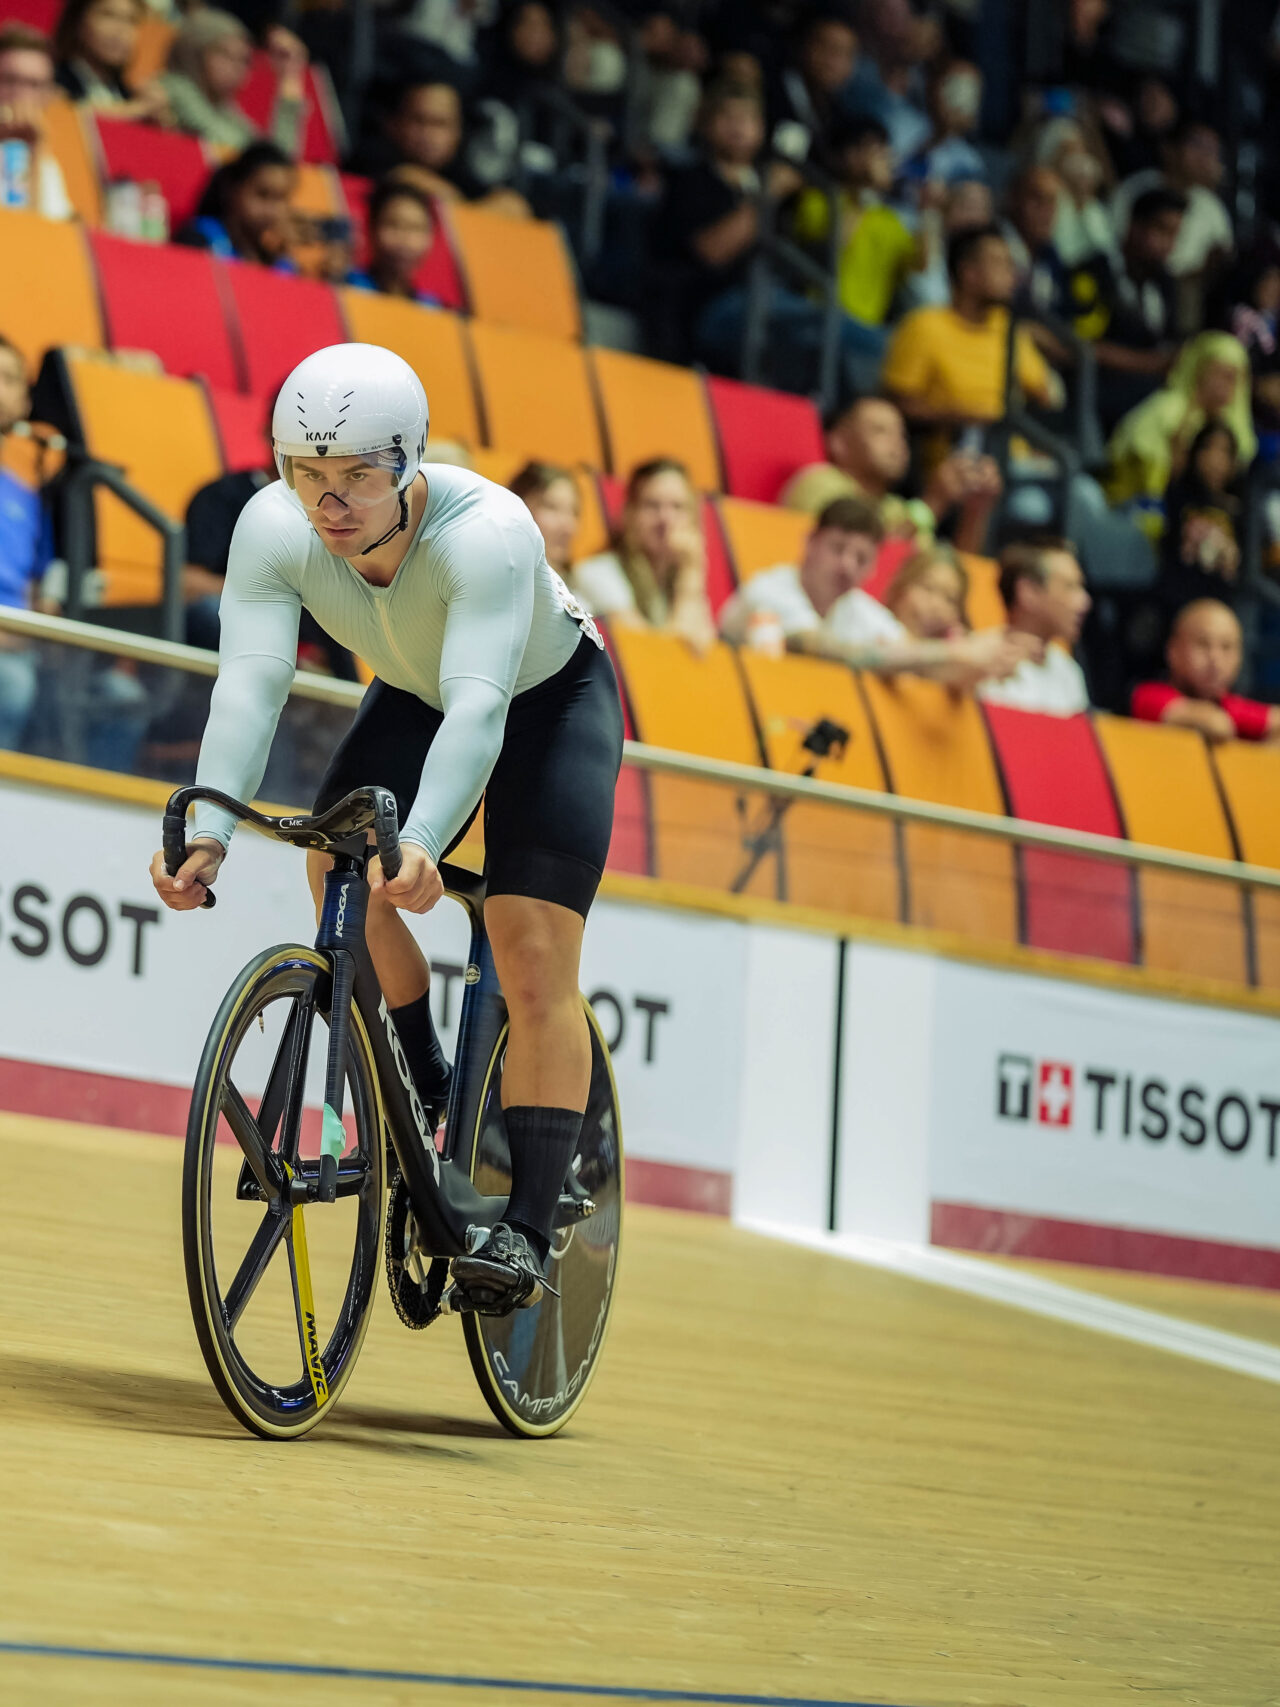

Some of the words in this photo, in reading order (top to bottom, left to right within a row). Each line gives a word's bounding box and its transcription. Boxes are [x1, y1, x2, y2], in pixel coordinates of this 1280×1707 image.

[305, 431, 337, 441] KASK
[335, 883, 350, 938] KOGA
[1084, 1069, 1280, 1160] TISSOT
[305, 1311, 327, 1396] MAVIC
